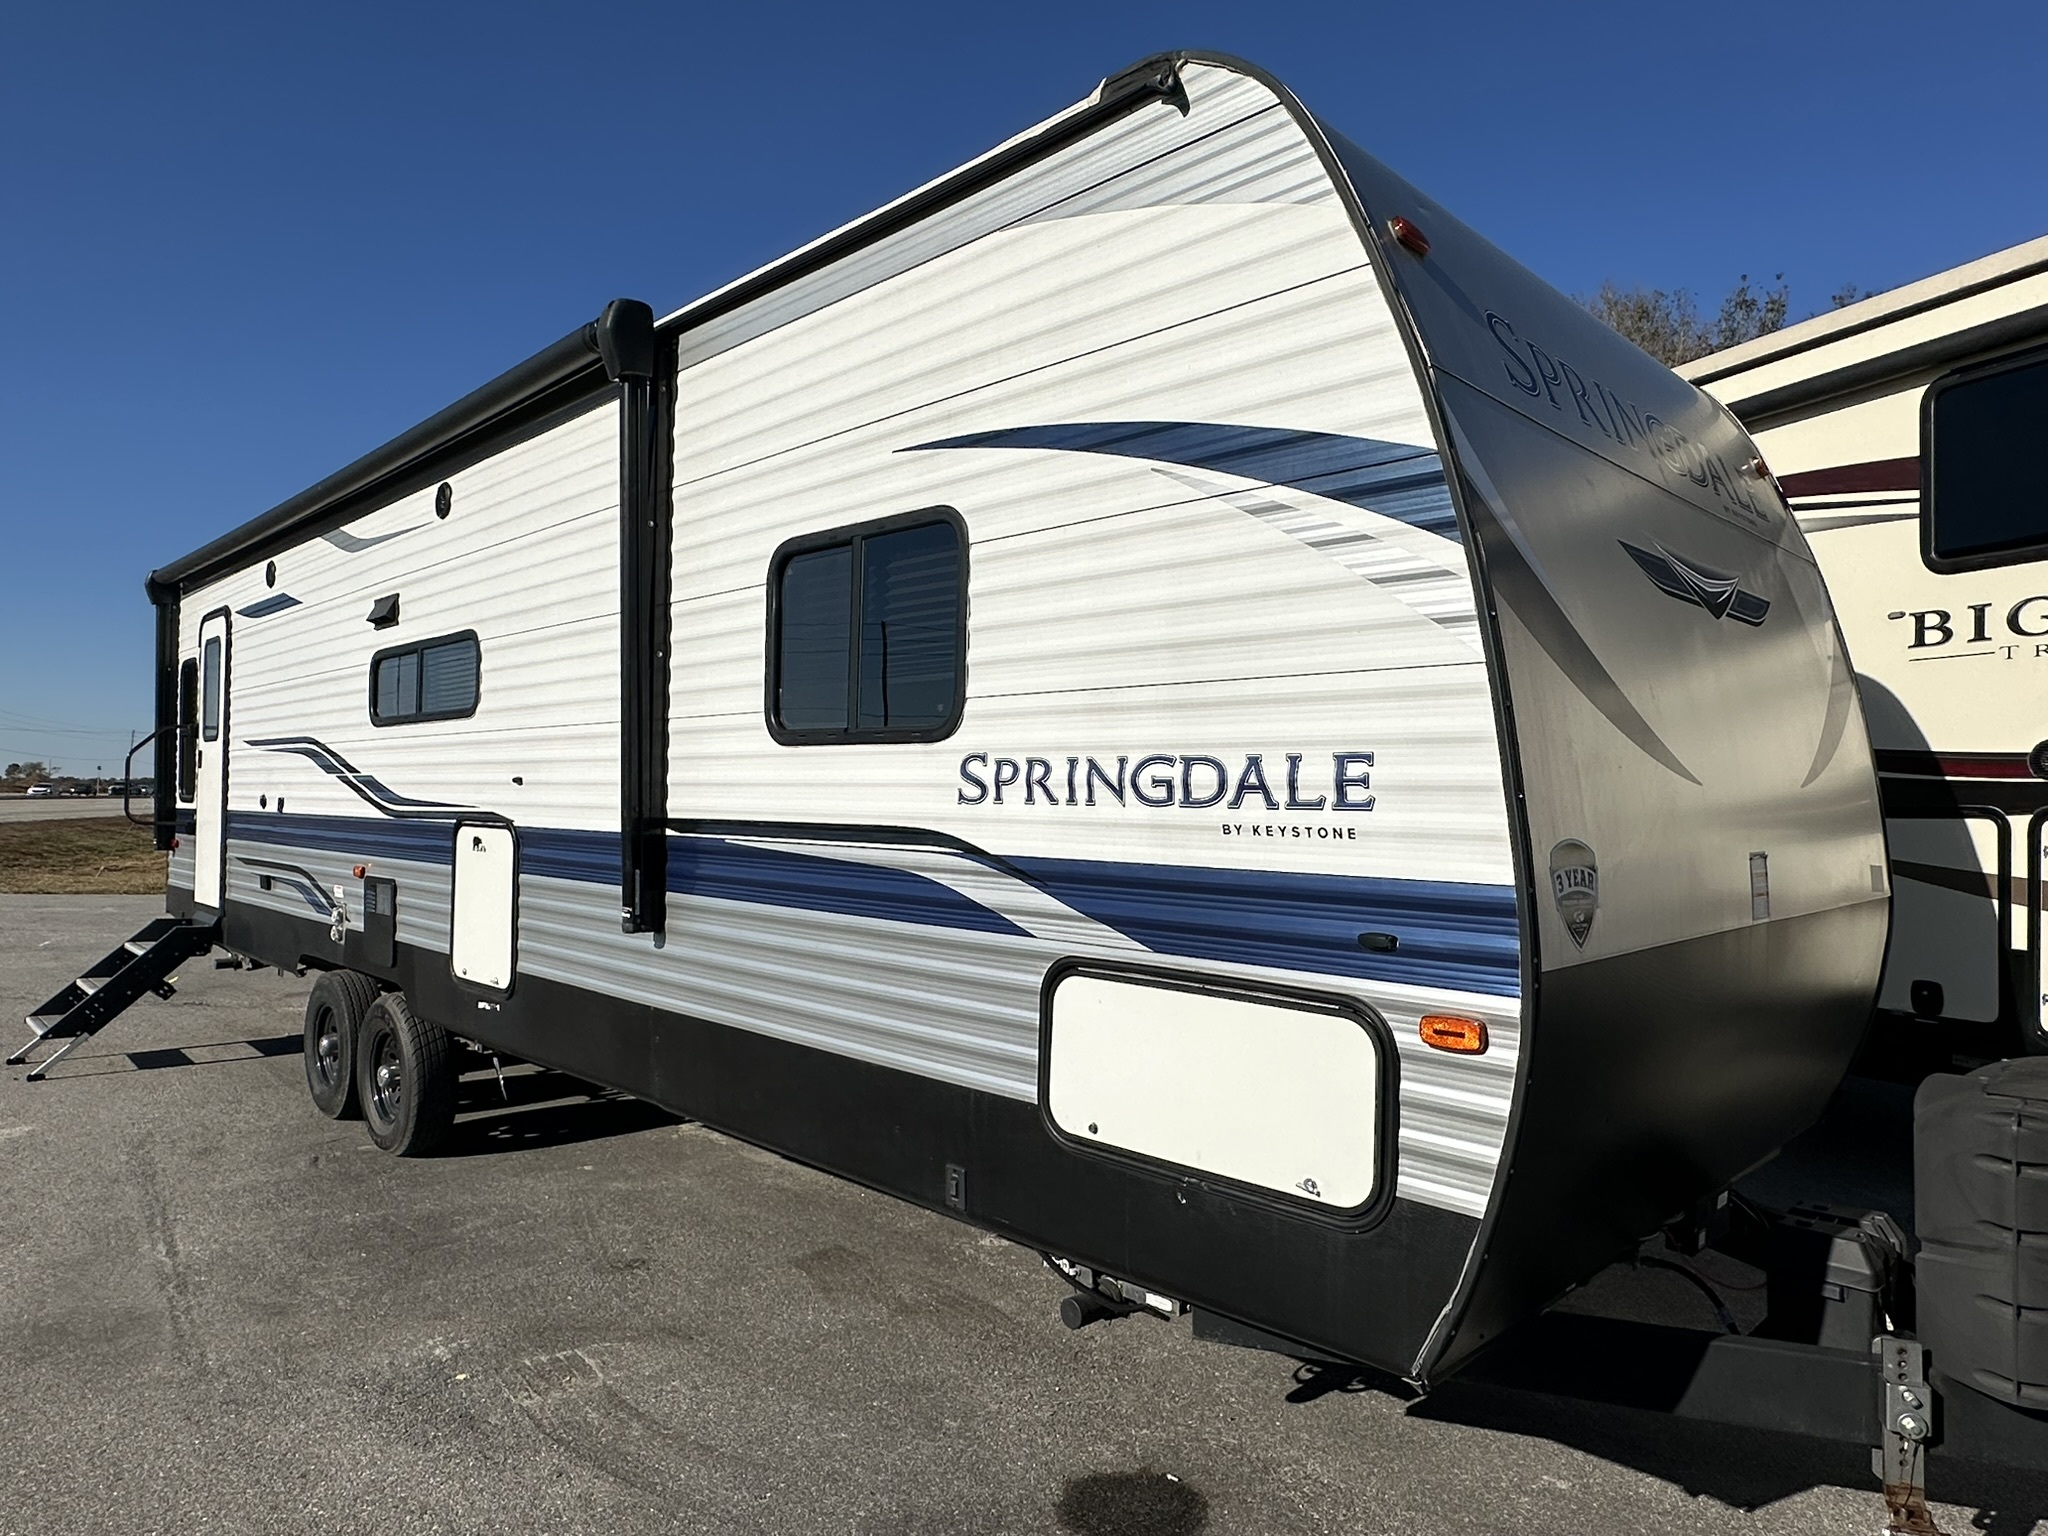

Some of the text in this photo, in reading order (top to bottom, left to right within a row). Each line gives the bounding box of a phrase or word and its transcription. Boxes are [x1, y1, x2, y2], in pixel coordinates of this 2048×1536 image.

[1485, 310, 1770, 523] SPRINGDALE
[957, 752, 1376, 811] SPRINGDALE
[1222, 825, 1357, 840] BY KEYSTONE
[1556, 868, 1594, 893] 3 YEAR
